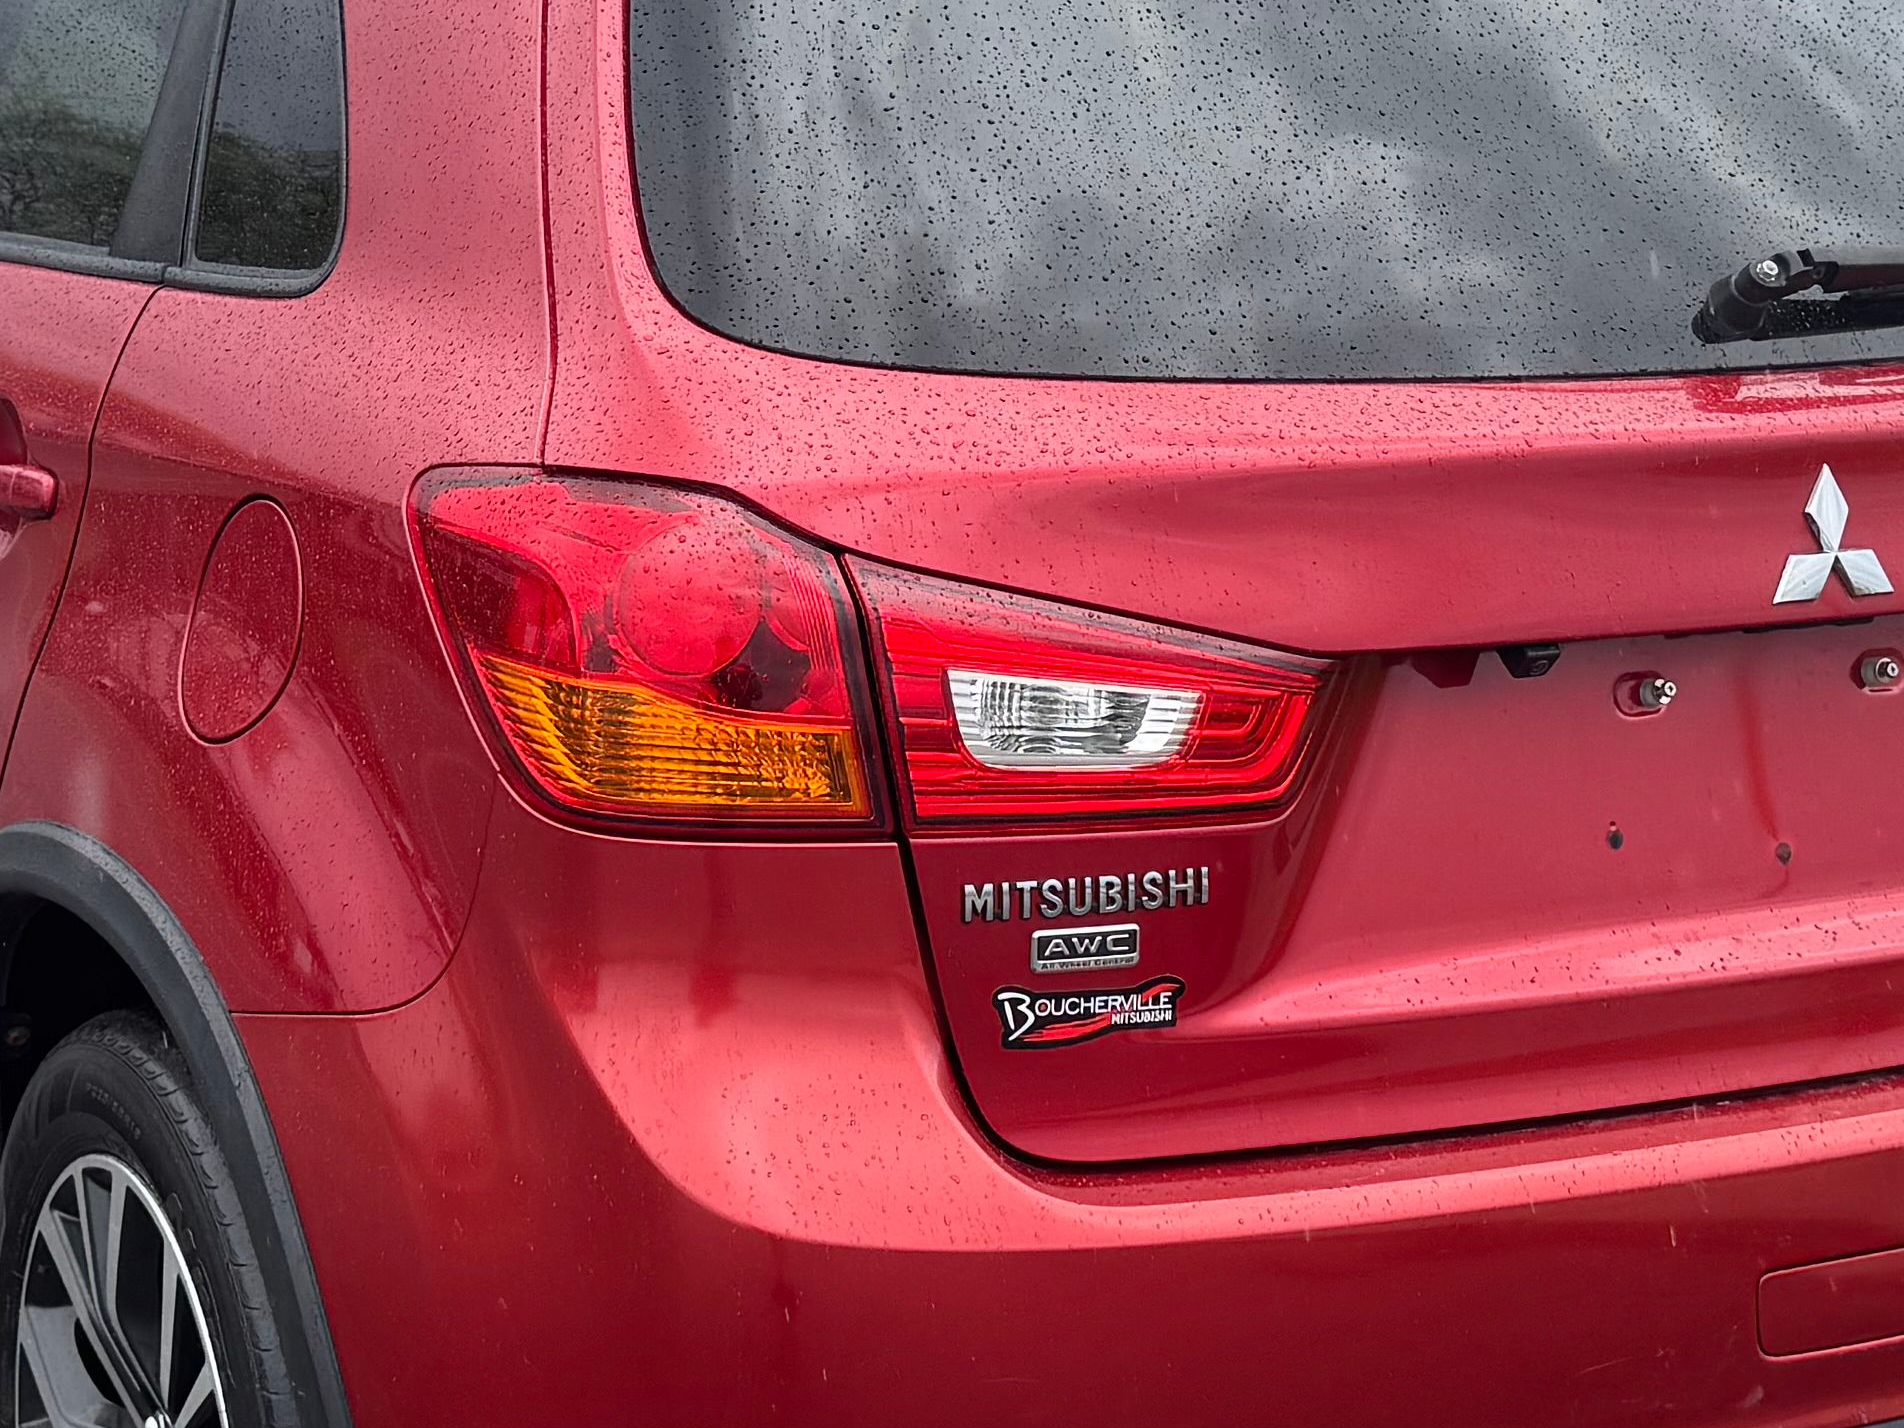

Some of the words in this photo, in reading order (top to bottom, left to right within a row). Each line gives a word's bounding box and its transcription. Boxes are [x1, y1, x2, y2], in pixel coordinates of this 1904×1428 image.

[963, 865, 1210, 923] MITSUBISHI
[1043, 933, 1130, 957] AWC
[997, 991, 1173, 1042] BOUCHERVILLE
